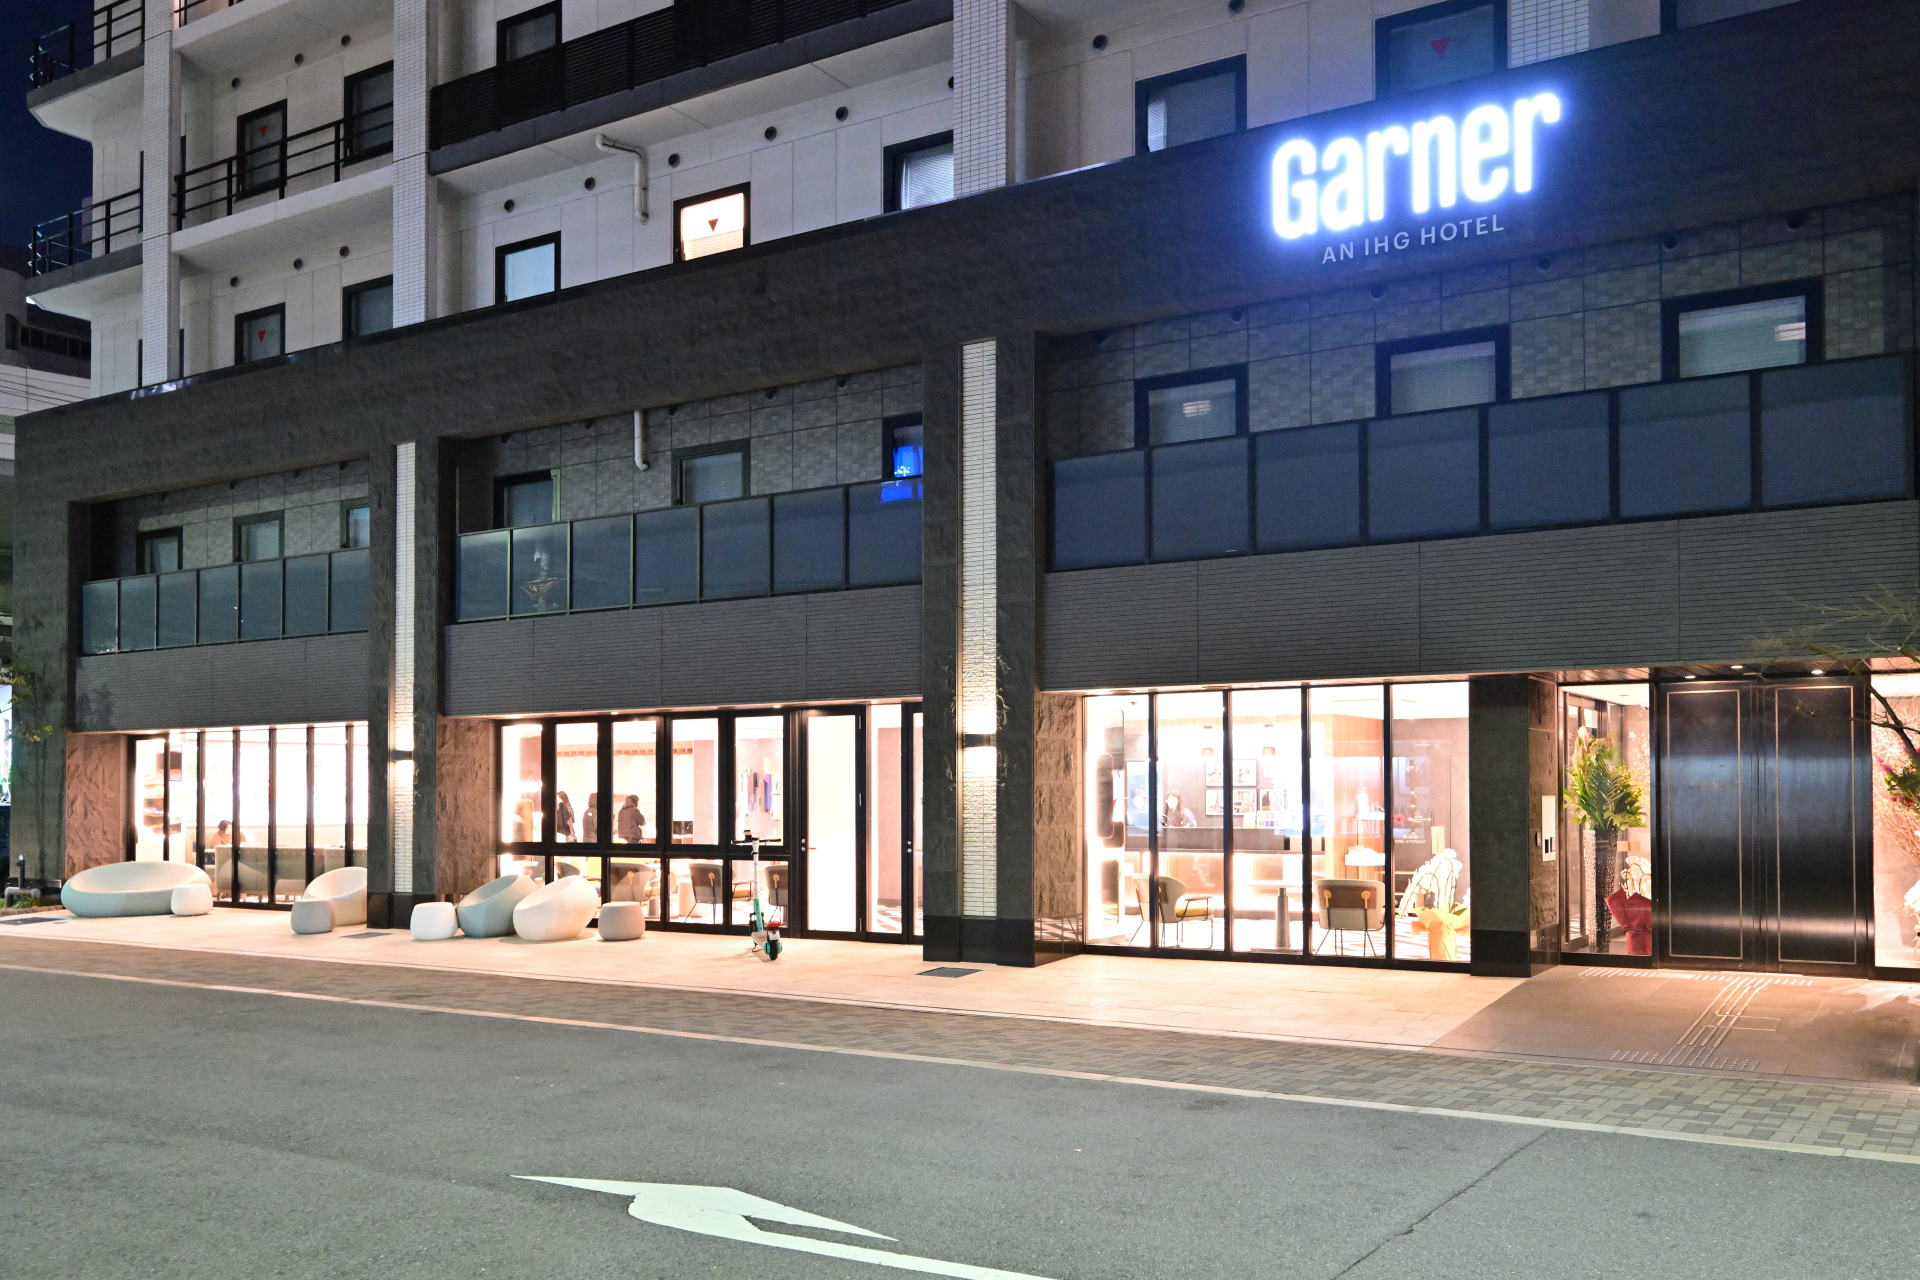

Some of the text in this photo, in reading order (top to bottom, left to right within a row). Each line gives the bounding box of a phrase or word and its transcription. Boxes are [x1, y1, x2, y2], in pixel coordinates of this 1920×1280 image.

[1271, 92, 1561, 239] Garner
[1322, 214, 1505, 264] AN IHG HOTEL
